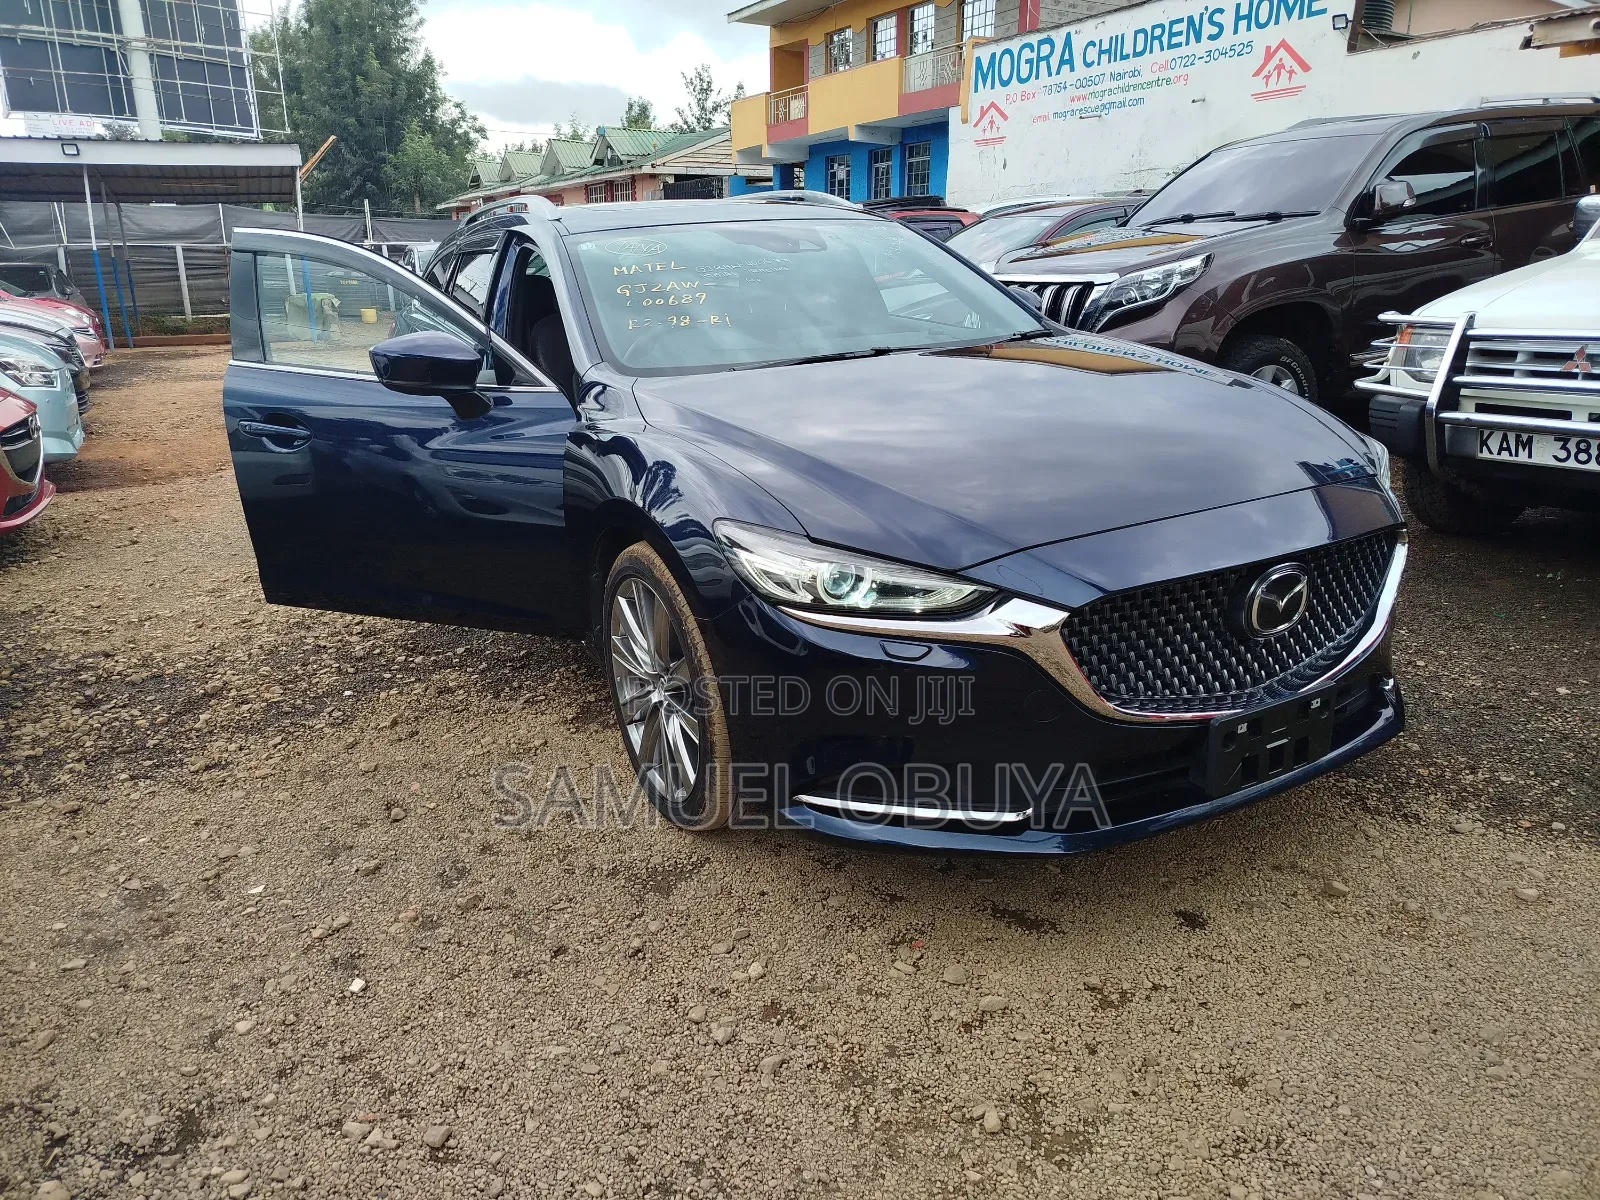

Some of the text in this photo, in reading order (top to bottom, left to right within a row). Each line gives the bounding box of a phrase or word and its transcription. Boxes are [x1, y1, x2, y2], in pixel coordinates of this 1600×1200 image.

[973, 31, 1076, 94] MOGRA
[1082, 5, 1226, 68] CHILDREN'S
[1479, 429, 1600, 467] KAM 38
